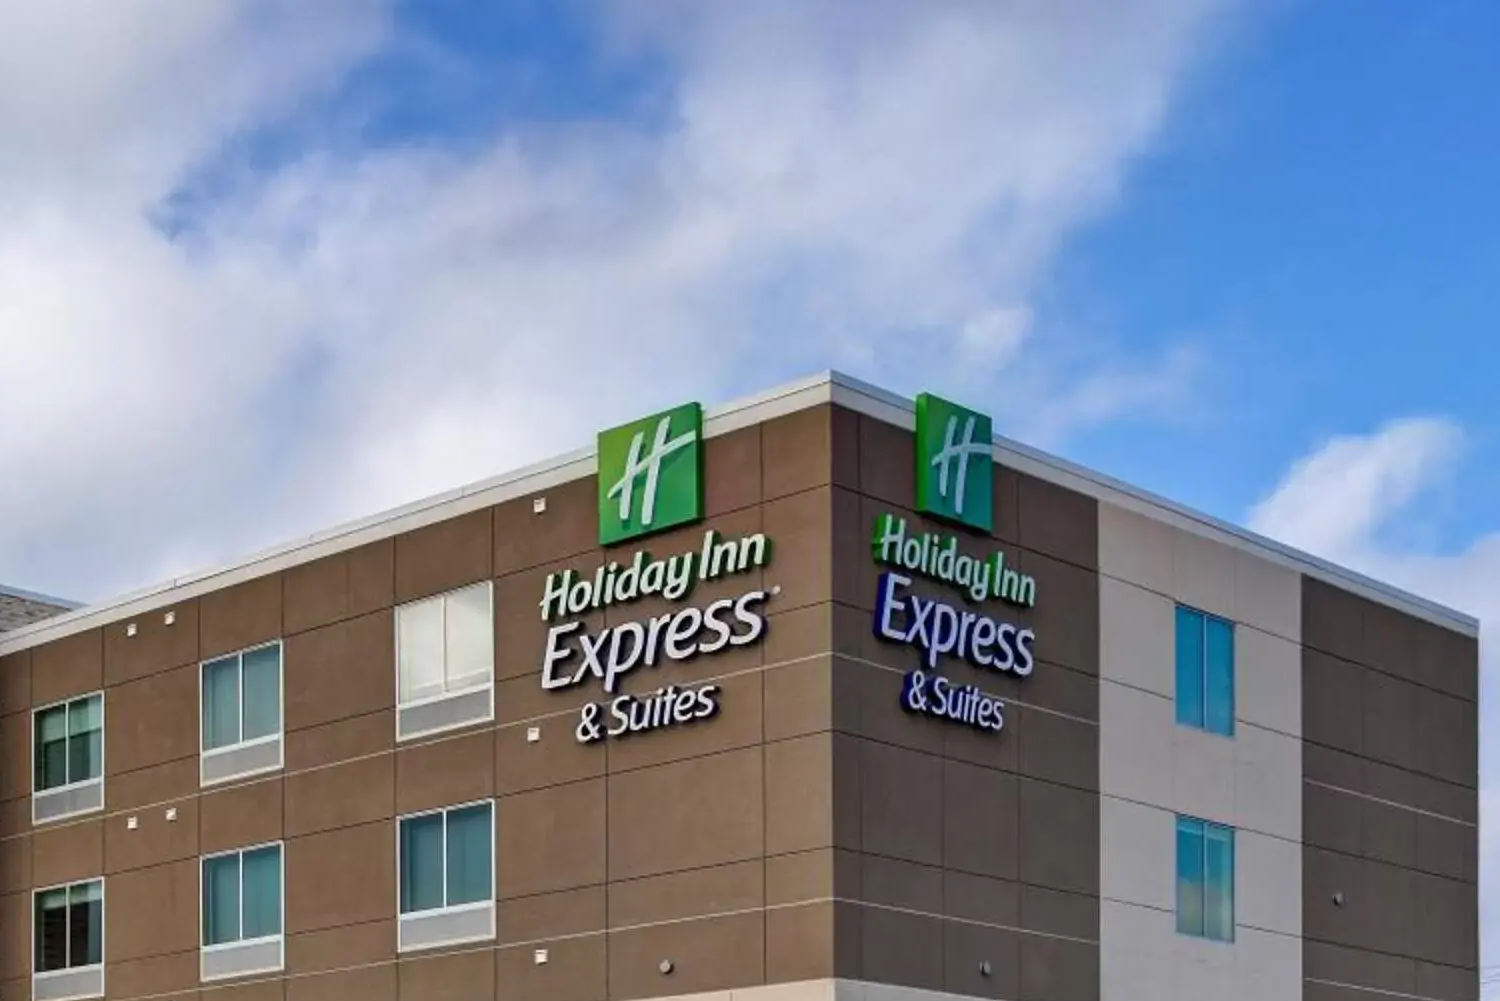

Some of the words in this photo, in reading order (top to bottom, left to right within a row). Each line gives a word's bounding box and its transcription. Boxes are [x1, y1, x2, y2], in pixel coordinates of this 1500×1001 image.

[539, 550, 693, 621] Holiday
[699, 530, 766, 580] Inn
[880, 513, 991, 602] Holiday
[994, 551, 1036, 608] Inn
[541, 591, 766, 693] Express
[881, 572, 1036, 677] Express
[575, 702, 601, 743] &
[607, 685, 717, 736] Suites
[907, 670, 927, 712] &
[931, 676, 1005, 731] Suites
